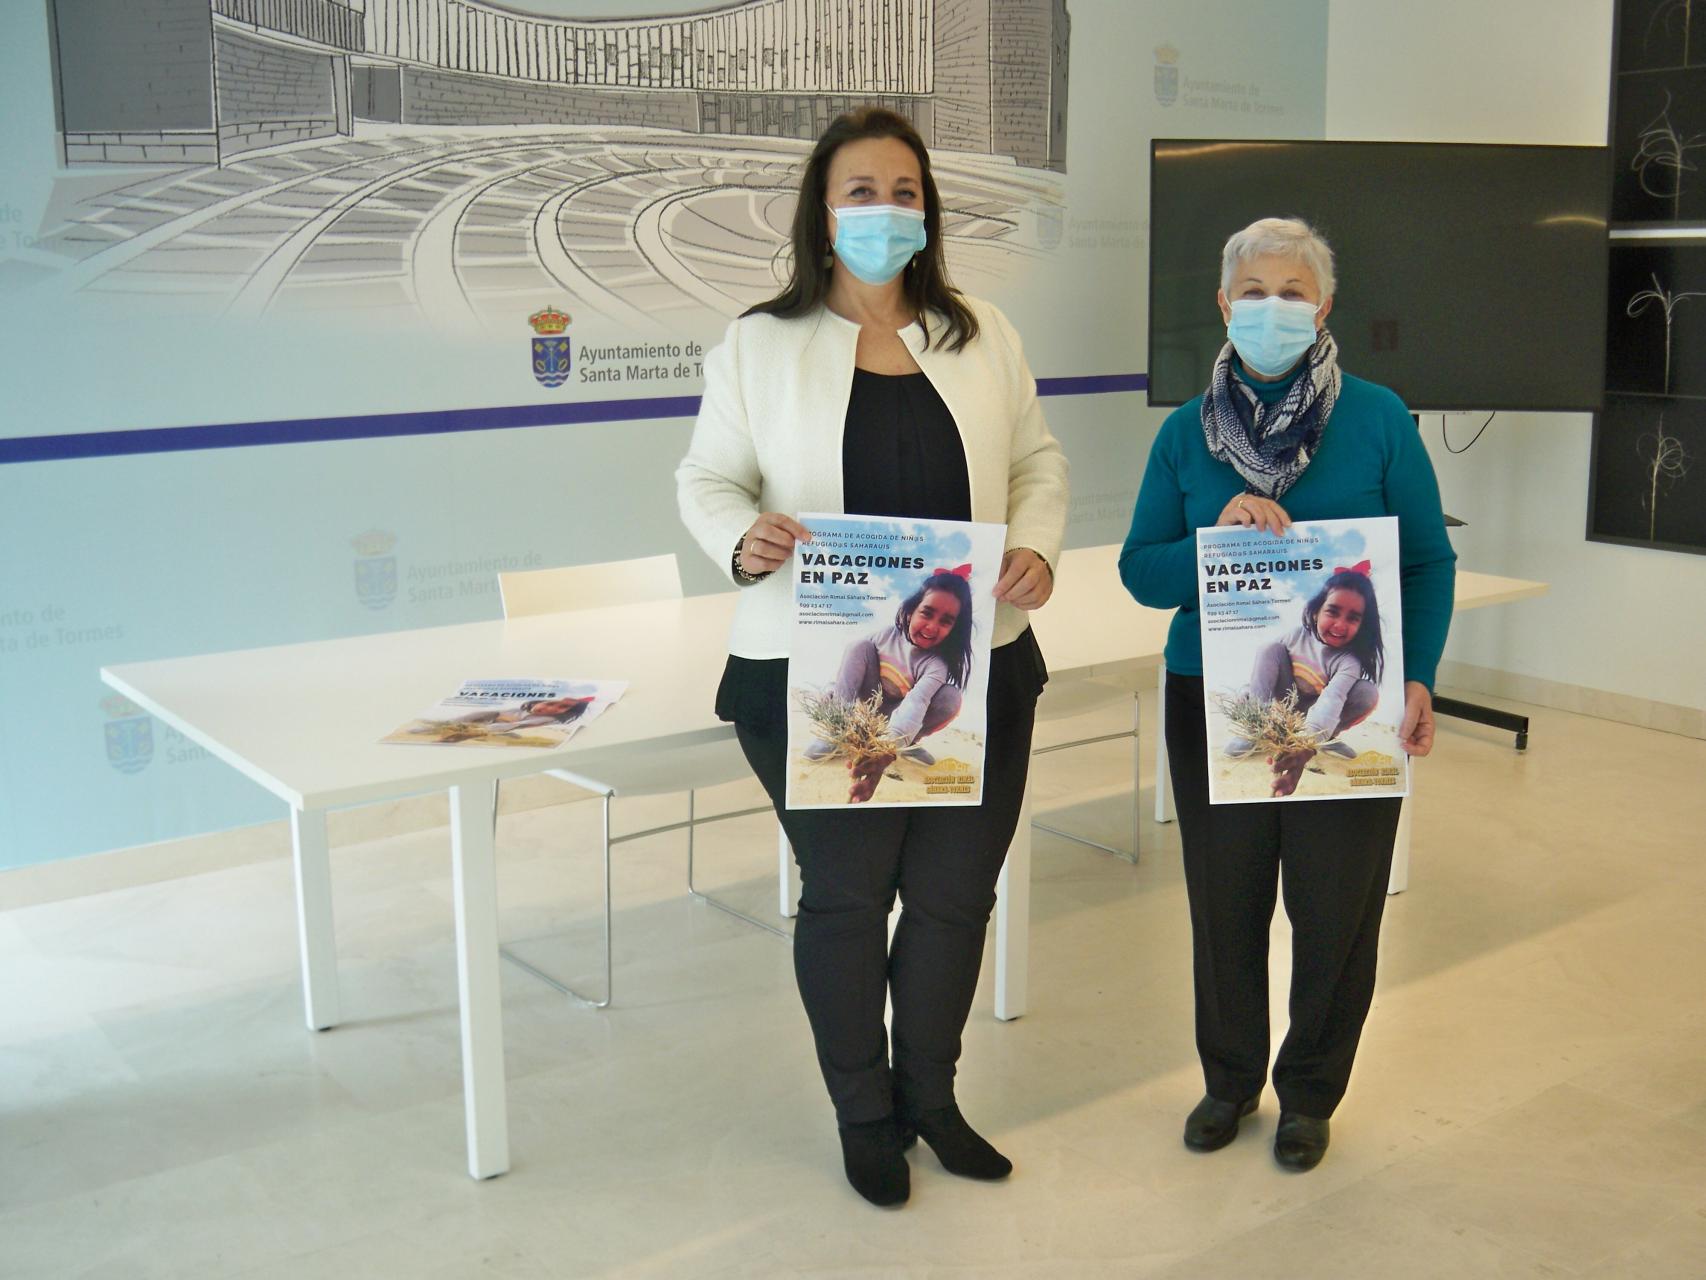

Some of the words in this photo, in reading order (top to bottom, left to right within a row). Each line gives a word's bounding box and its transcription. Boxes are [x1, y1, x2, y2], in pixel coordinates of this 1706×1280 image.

[578, 342, 680, 365] Ayuntamiento
[685, 341, 702, 357] de
[580, 366, 621, 383] Santa
[626, 364, 669, 381] Marta
[673, 362, 690, 379] de
[855, 533, 888, 541] ACOGIDA
[849, 542, 891, 550] SAHARAUIS
[1203, 542, 1241, 550] PROGRAMA
[1253, 539, 1284, 547] ACOGIDA
[1249, 547, 1288, 556] SAHARAUIS
[801, 553, 925, 570] VACACIONES
[1205, 558, 1324, 577] VACACIONES
[800, 571, 825, 584] EN
[831, 571, 869, 585] PAZ
[1206, 581, 1229, 593] EN
[1236, 578, 1272, 592] PAZ
[1271, 597, 1291, 605] Tormes
